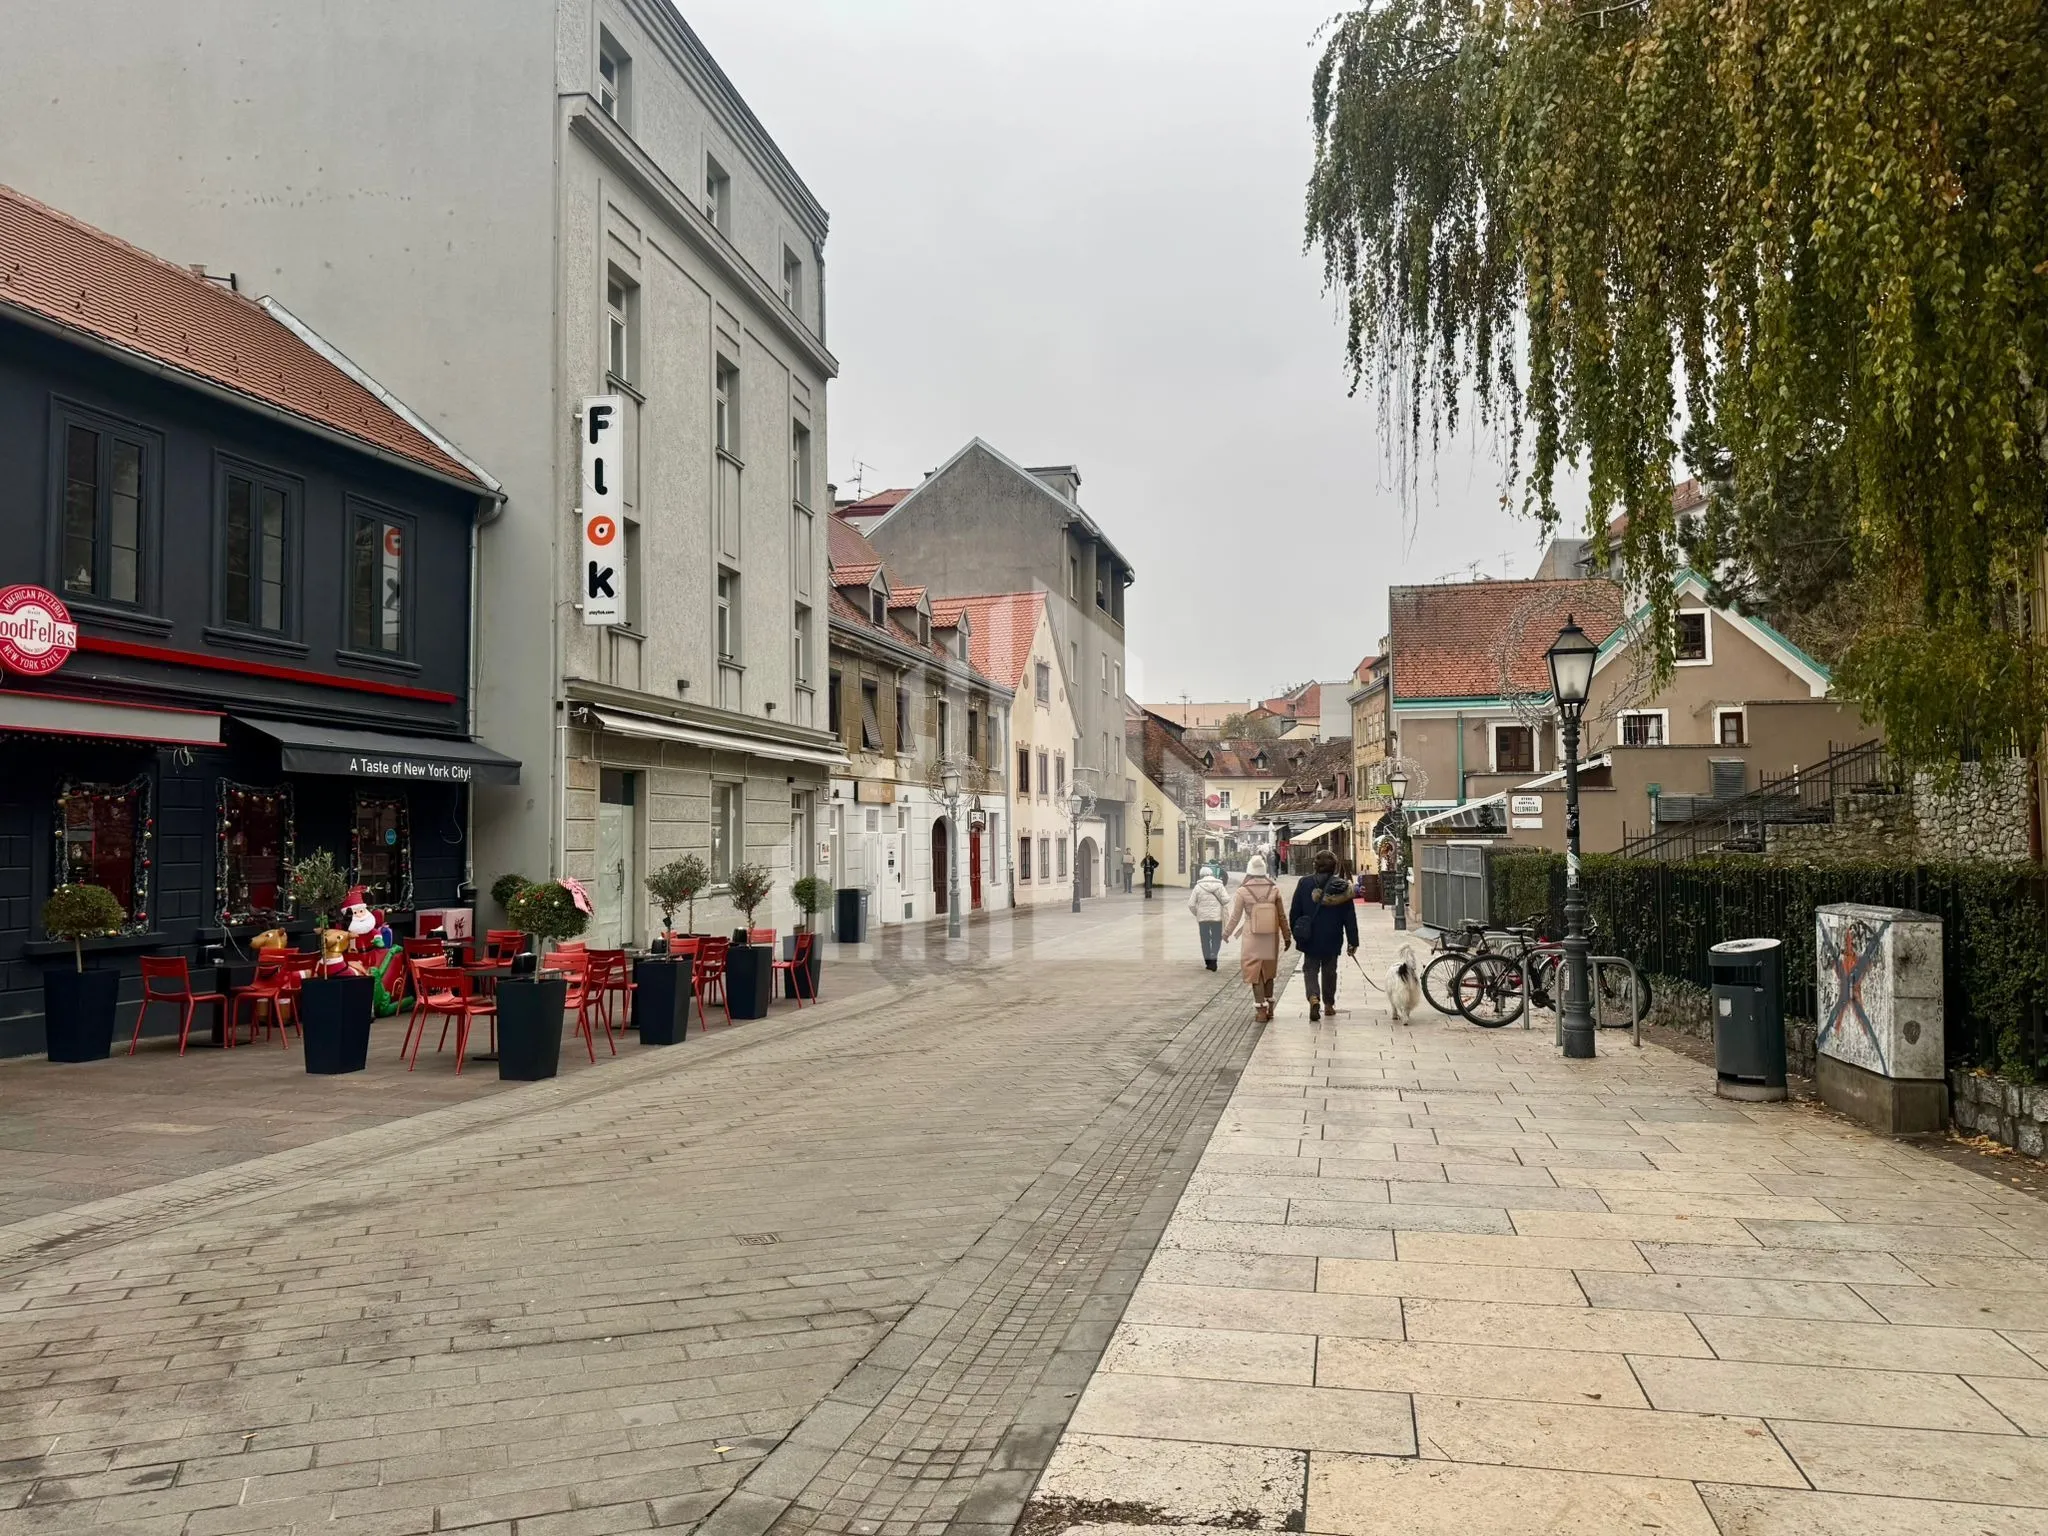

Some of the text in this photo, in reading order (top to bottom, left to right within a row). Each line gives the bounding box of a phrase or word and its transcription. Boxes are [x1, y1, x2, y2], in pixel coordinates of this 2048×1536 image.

[2, 589, 65, 619] AMERICAN PIZZERIA
[0, 618, 75, 646] oodFellas
[3, 644, 61, 670] NEW YORK STYLE
[350, 758, 471, 782] A Taste of New York City!
